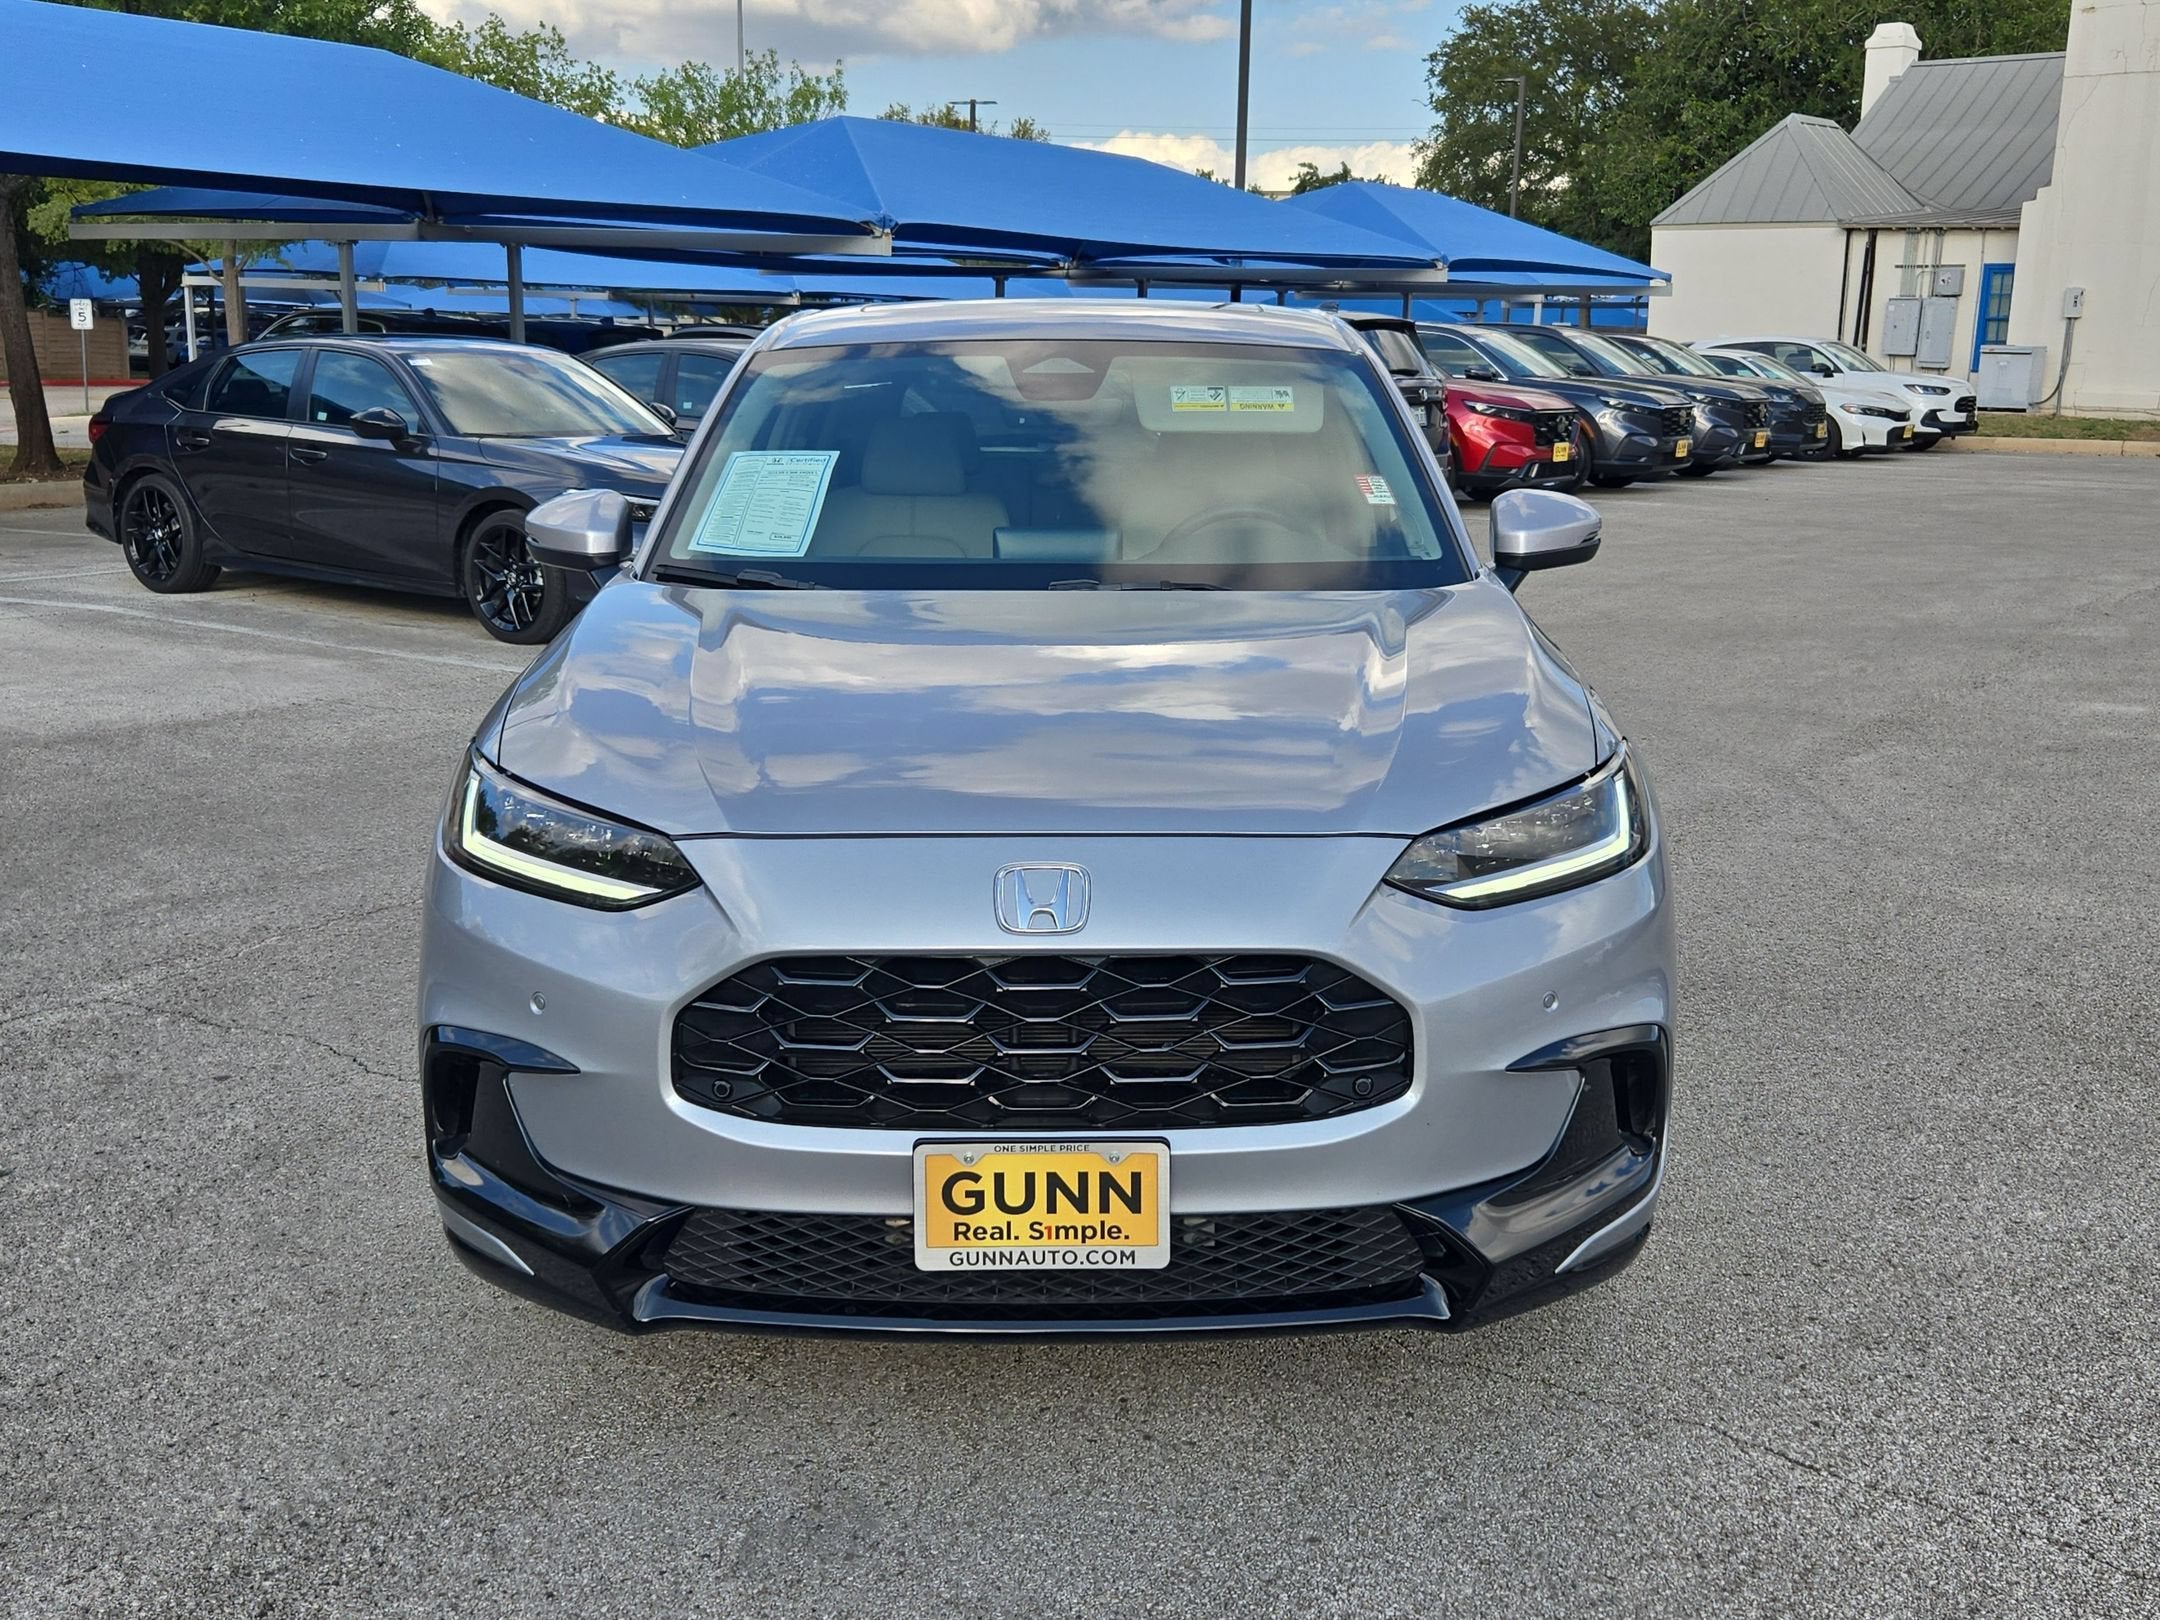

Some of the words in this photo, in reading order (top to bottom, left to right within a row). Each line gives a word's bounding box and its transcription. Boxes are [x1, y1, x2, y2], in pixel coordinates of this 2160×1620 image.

[78, 312, 87, 322] 5
[993, 1145, 1017, 1153] ONE
[1019, 1144, 1057, 1153] SIMPLE
[1059, 1144, 1090, 1152] PRICE
[941, 1170, 1142, 1216] GUNN
[953, 1221, 1020, 1241] Real.
[949, 1249, 1136, 1267] GUNNAUTO.COM
